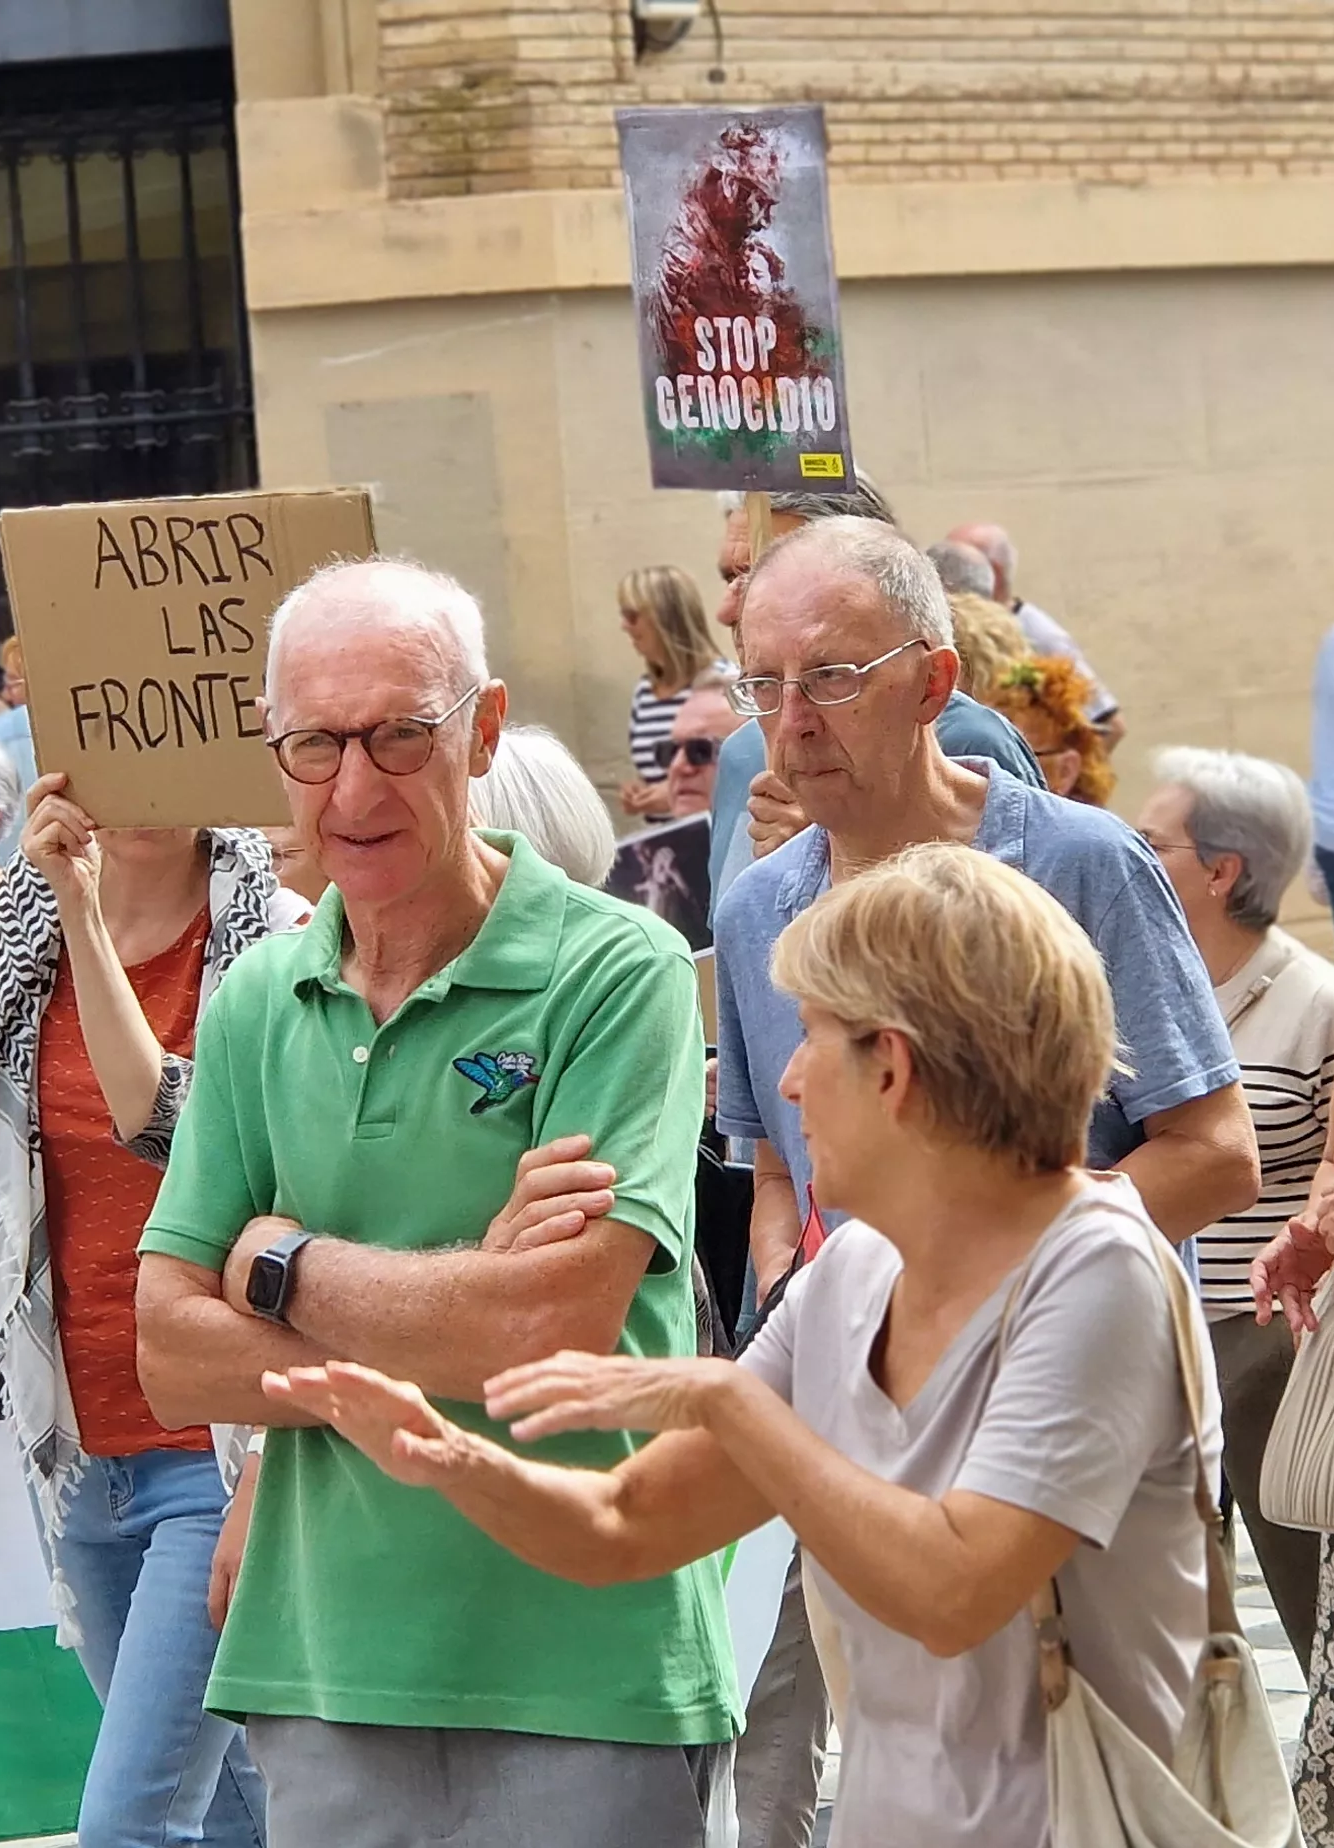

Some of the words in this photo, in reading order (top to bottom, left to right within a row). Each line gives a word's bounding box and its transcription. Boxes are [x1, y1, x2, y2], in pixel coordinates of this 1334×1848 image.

[695, 316, 777, 372] STOP
[655, 375, 835, 432] GENOCIDIO
[94, 513, 274, 590] ABRIR
[161, 597, 255, 657] LAS
[70, 672, 267, 752] FRONTE
